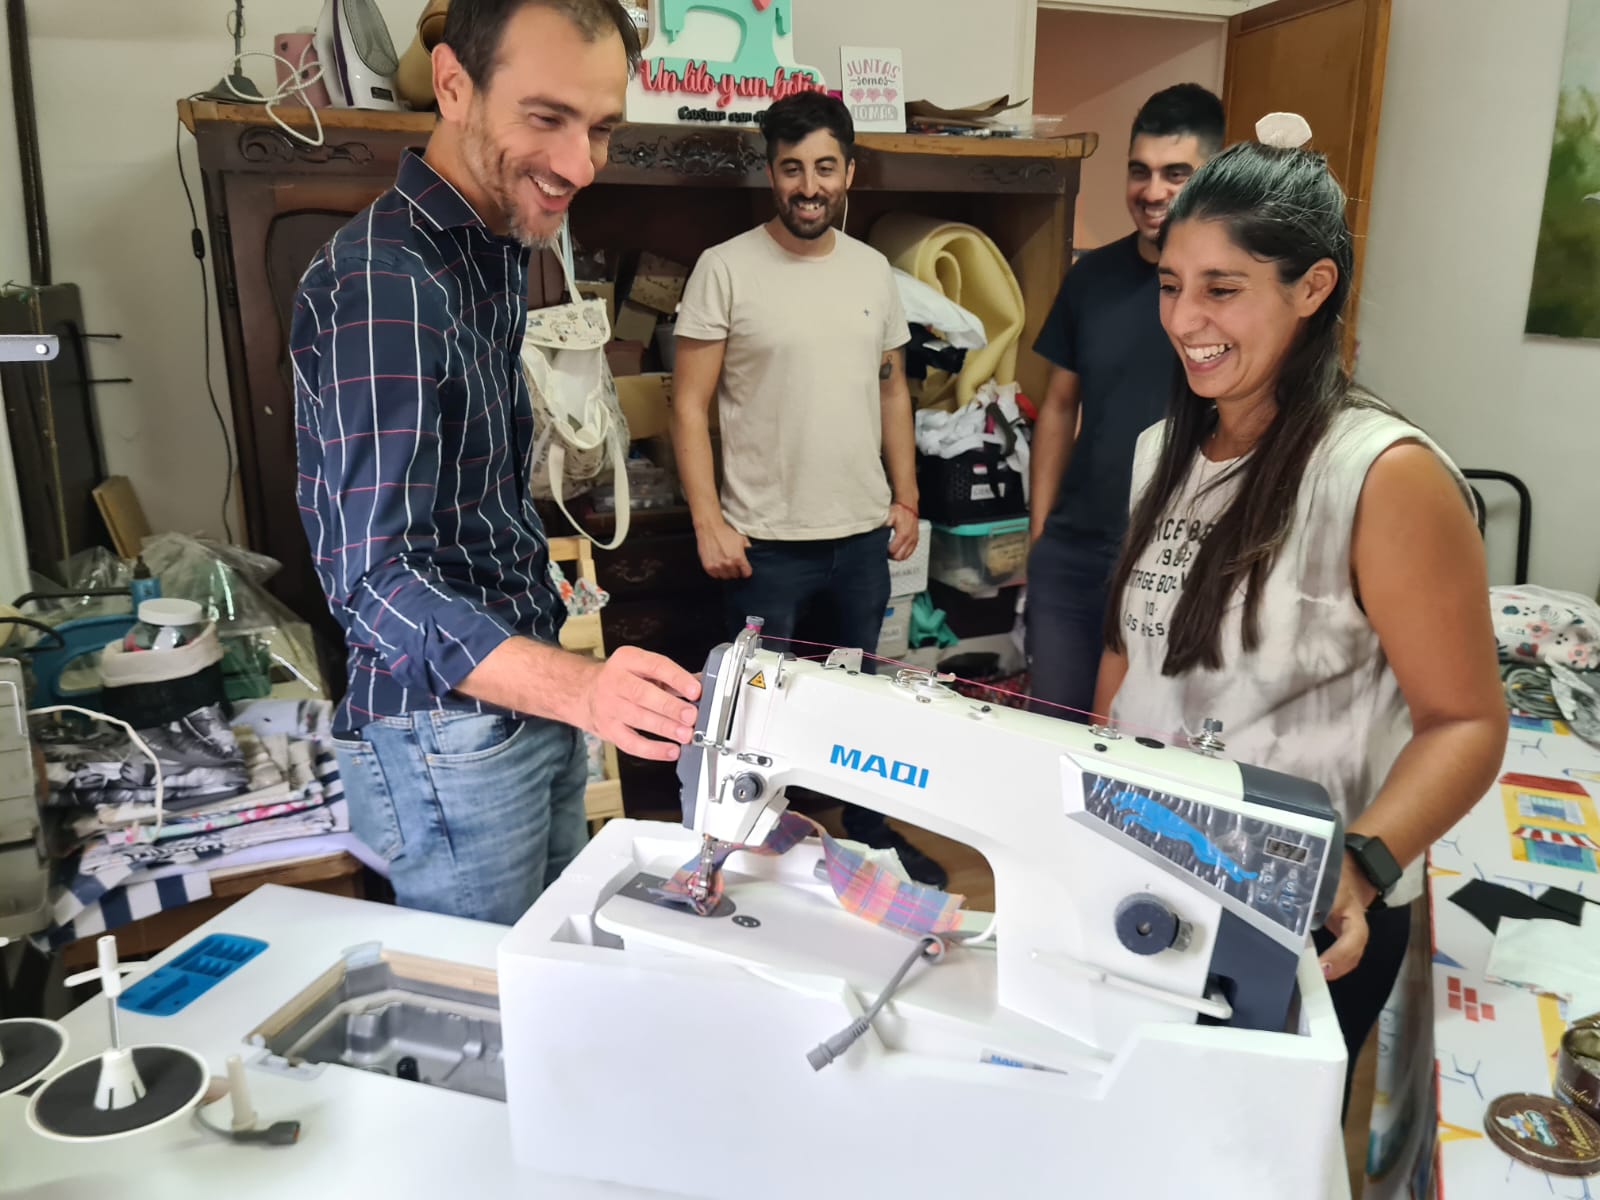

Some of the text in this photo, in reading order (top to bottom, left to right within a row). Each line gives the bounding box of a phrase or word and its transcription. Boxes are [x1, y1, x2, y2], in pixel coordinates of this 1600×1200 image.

[639, 57, 679, 93] Un
[716, 73, 736, 108] y
[737, 76, 768, 98] un
[830, 744, 929, 789] MAQI
